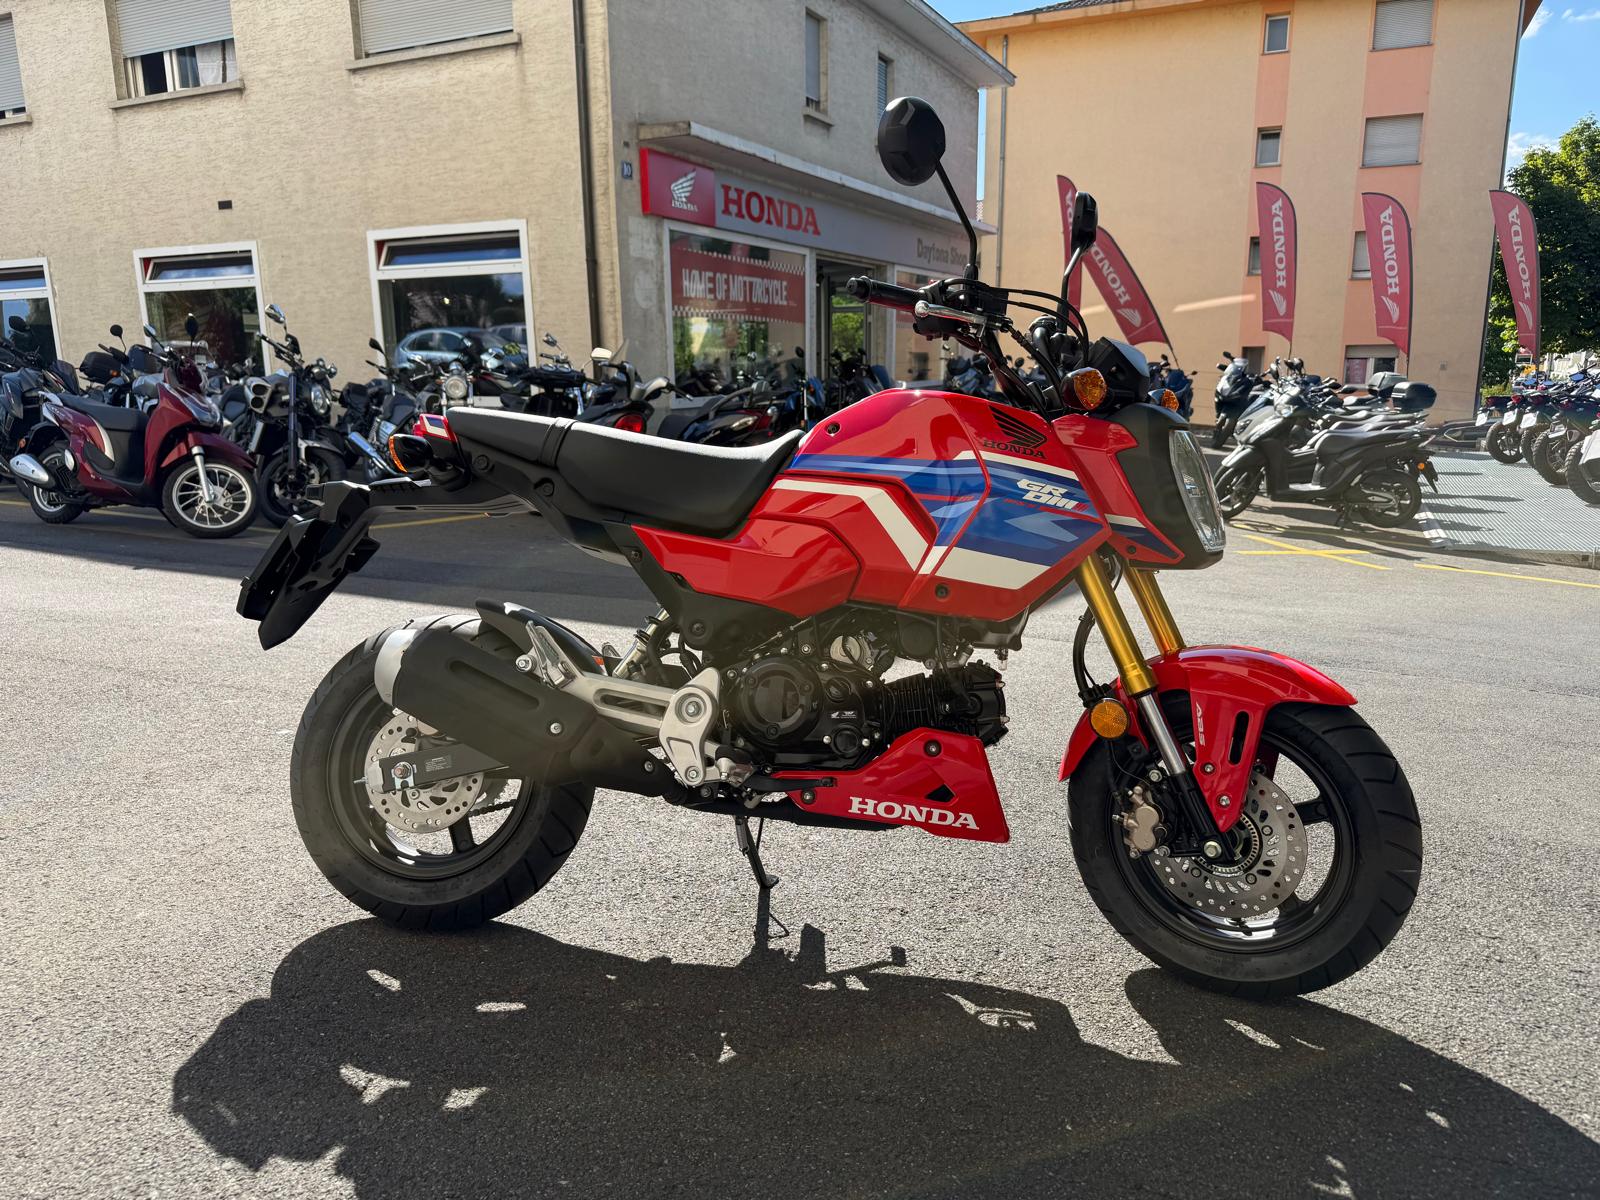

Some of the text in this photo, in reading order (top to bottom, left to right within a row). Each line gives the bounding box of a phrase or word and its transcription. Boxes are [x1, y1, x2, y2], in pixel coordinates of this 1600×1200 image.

[721, 184, 821, 236] HONDA
[917, 238, 949, 265] Daytona
[1271, 198, 1287, 288] HONDA
[1380, 205, 1400, 294] HONDA
[1508, 204, 1531, 299] HONDA
[715, 272, 728, 301] OF
[1090, 243, 1132, 305] HOND
[983, 440, 1048, 460] HONDA
[1195, 701, 1206, 747] ABS
[848, 796, 980, 830] HONDA
